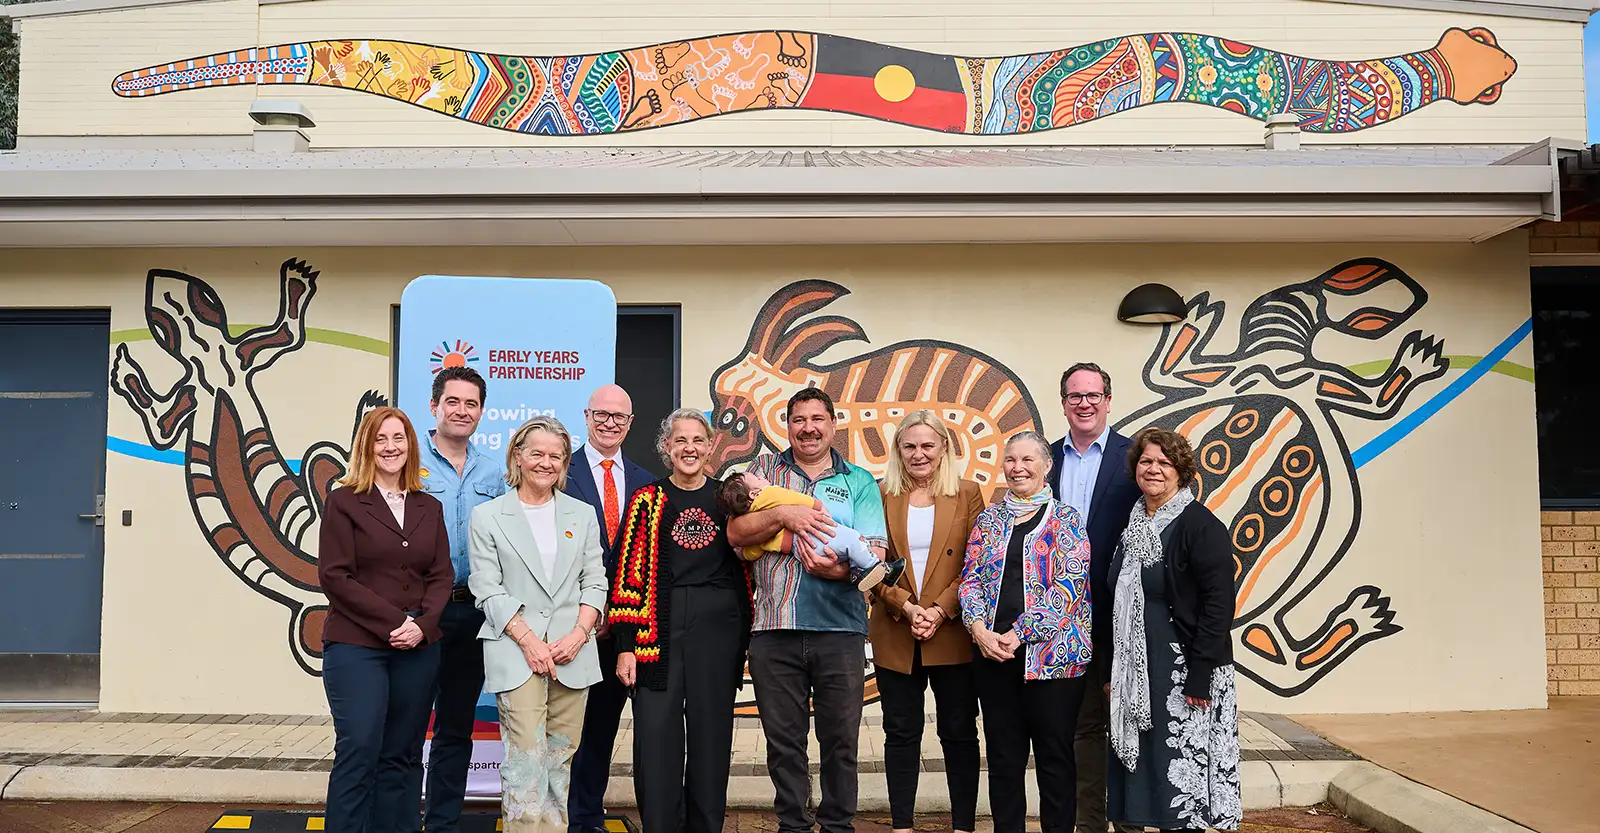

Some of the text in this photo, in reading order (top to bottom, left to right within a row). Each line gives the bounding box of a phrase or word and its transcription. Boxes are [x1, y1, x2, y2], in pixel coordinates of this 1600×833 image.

[489, 350, 579, 364] EARLY YEARS
[489, 366, 585, 380] PARTNERSHIP
[481, 403, 555, 420] rowin
[825, 486, 849, 499] NAIDOC
